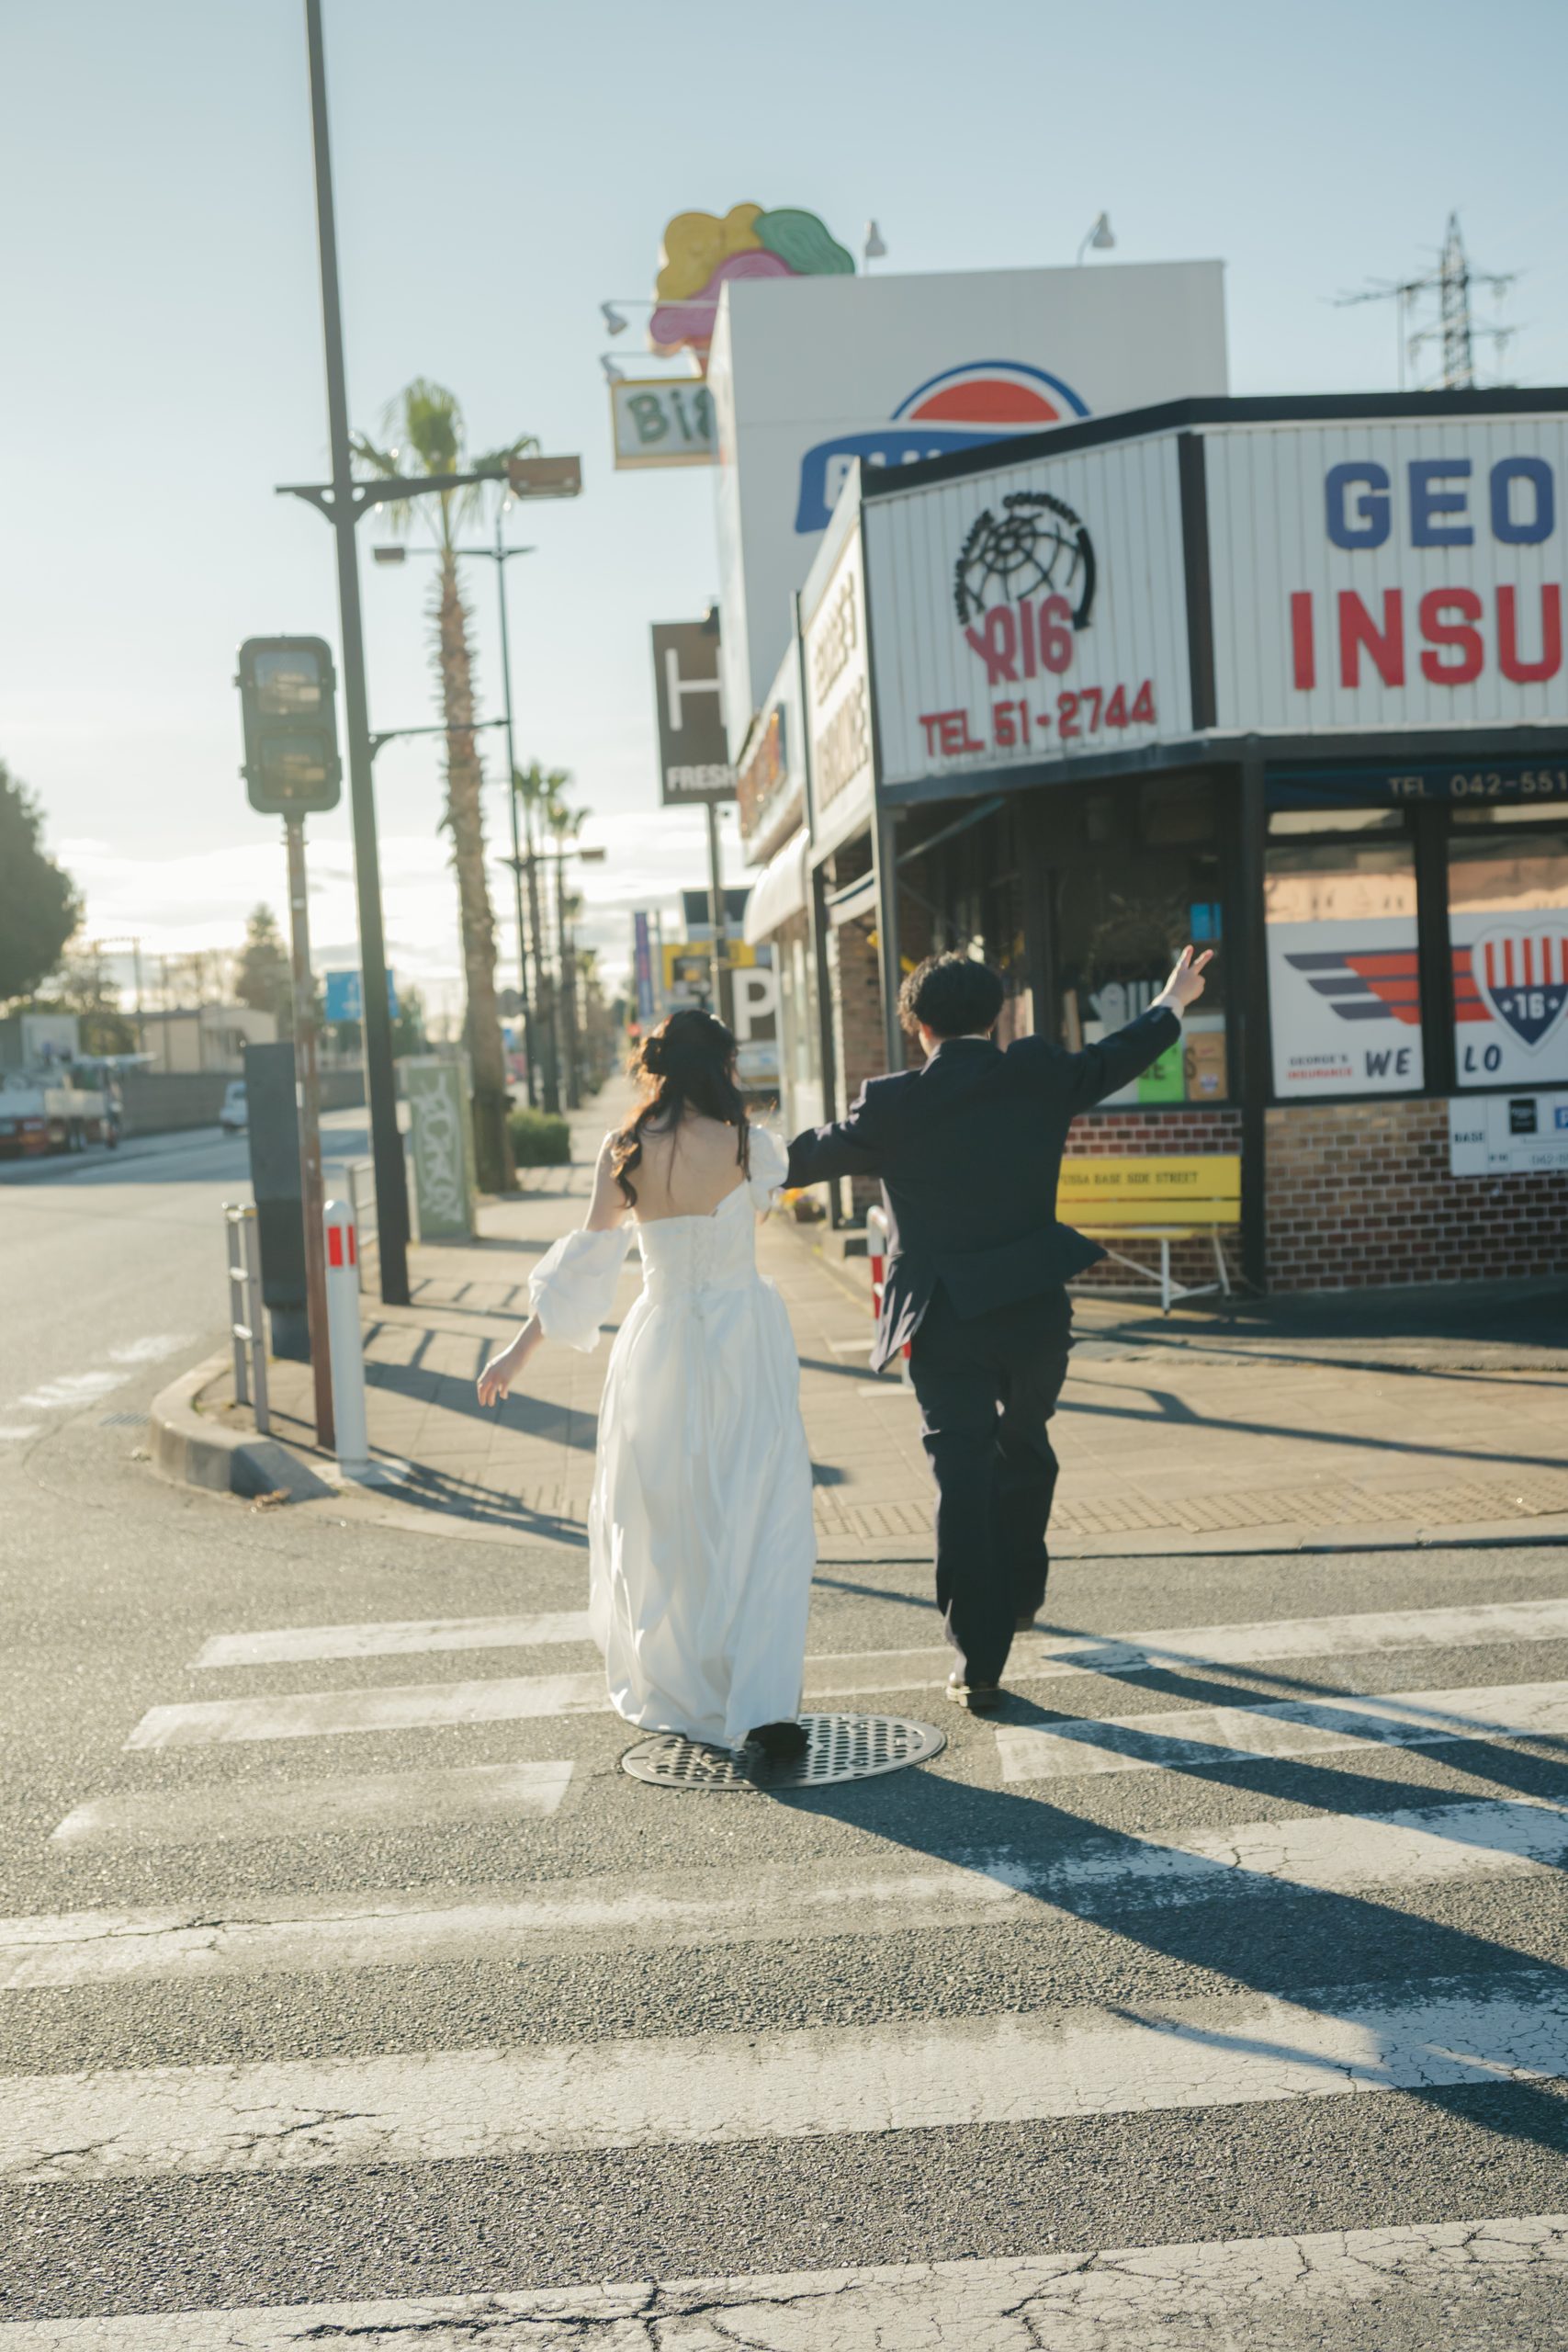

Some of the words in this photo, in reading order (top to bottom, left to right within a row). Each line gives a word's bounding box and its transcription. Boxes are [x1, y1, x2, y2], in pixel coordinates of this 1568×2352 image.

[1324, 456, 1555, 549] GEO
[1291, 583, 1562, 690] INSU
[919, 708, 985, 757] TEL
[993, 679, 1156, 747] 51-2744
[666, 764, 738, 791] FRESH
[1389, 776, 1433, 797] TEL
[1514, 992, 1545, 1020] 16
[1288, 1068, 1353, 1080] INSURANCE
[1364, 1047, 1412, 1078] WE
